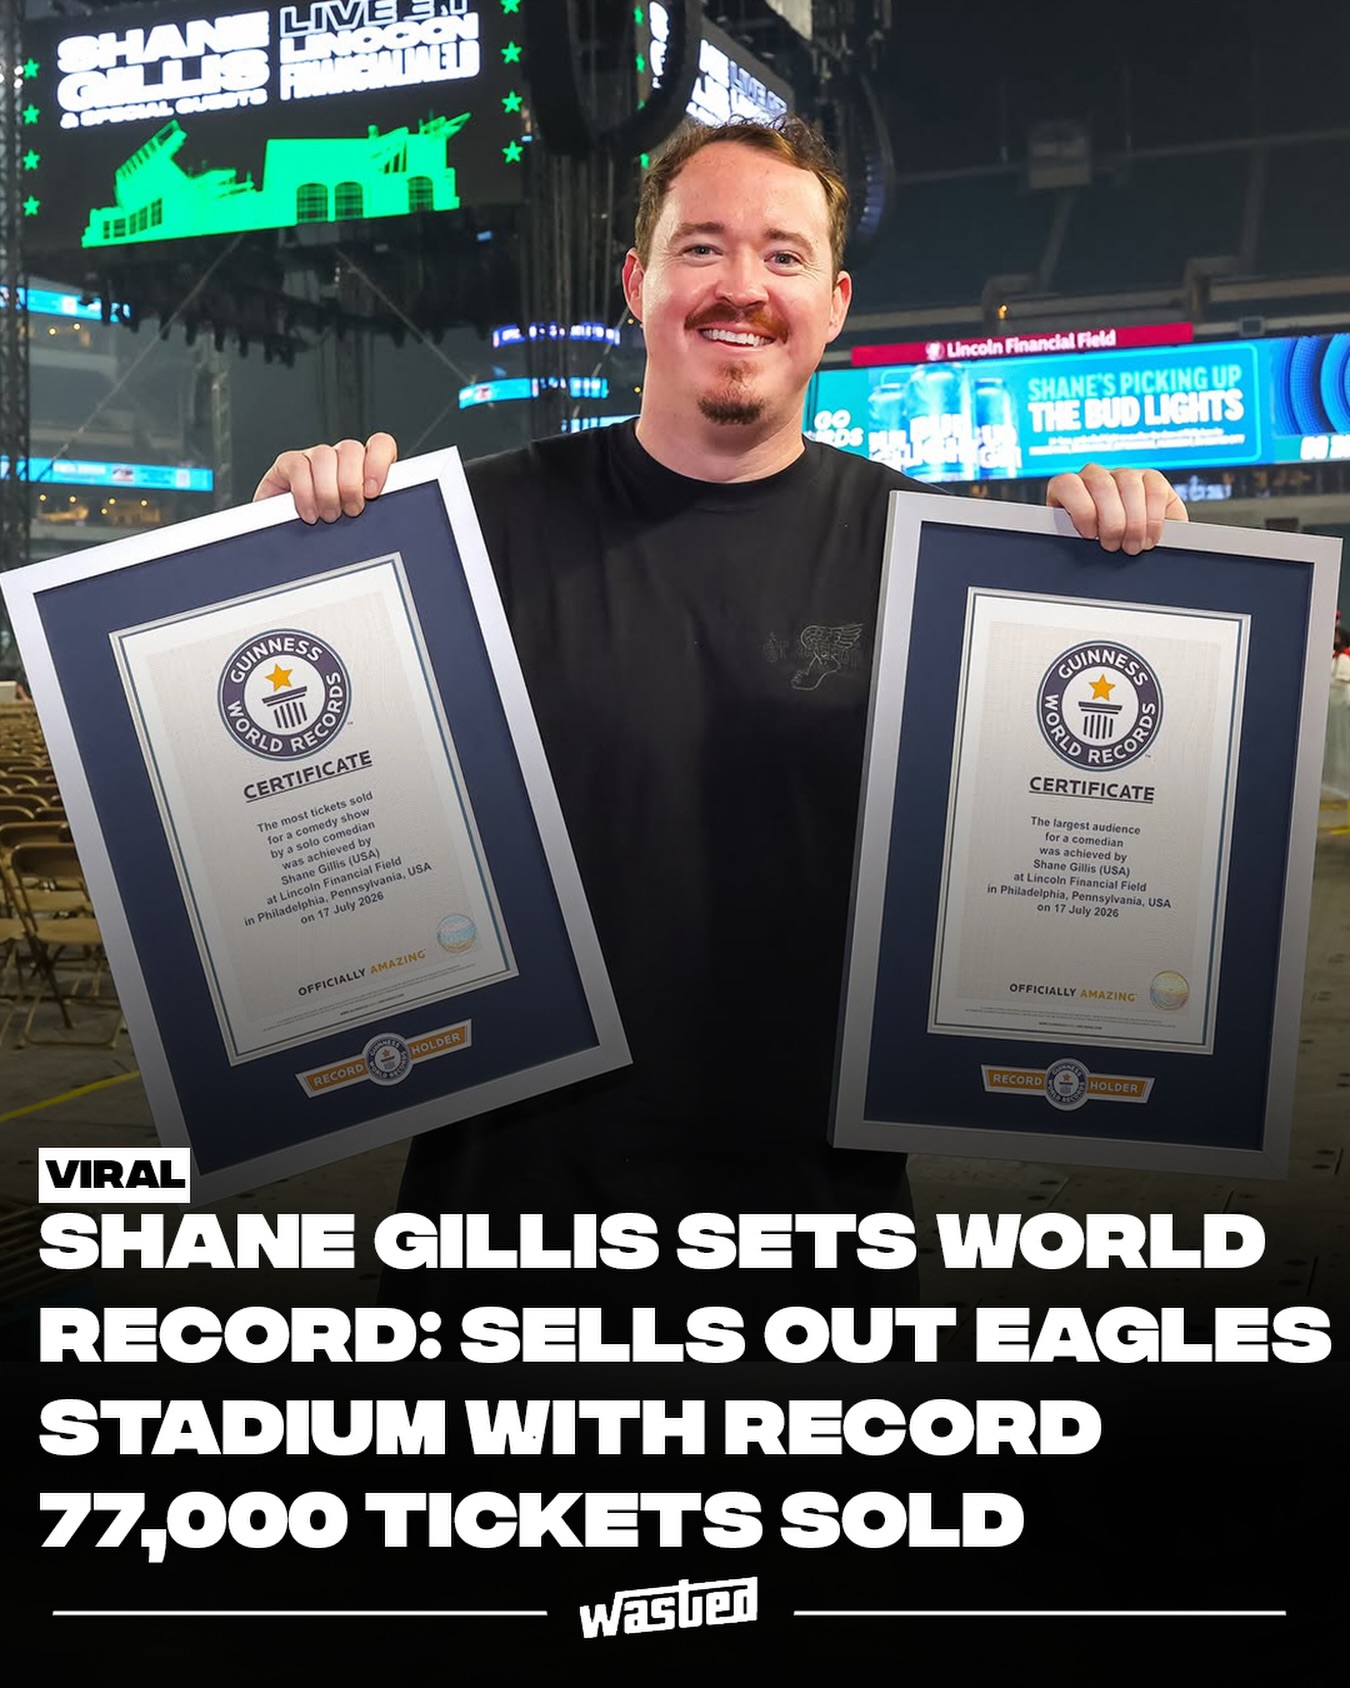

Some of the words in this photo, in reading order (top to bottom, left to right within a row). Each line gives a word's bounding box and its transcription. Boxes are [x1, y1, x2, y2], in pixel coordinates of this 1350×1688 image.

[280, 0, 398, 37] LIVE
[57, 11, 270, 73] SHANE
[57, 49, 270, 112] GILLIS
[947, 338, 1004, 359] Lincoln
[1005, 332, 1076, 354] Financial
[1077, 329, 1116, 349] Field
[1028, 371, 1116, 400] SHANE'S
[1120, 367, 1208, 395] PICKING
[1213, 364, 1242, 389] UP
[814, 409, 851, 431] GO
[1028, 399, 1081, 433] THE
[1085, 396, 1140, 429] BUD
[1144, 388, 1244, 426] LIGHTS
[230, 637, 323, 683] GUINNESS
[1058, 649, 1148, 686] GUINNESS
[227, 700, 283, 752] WORLD
[290, 672, 344, 752] RECORDS
[1044, 694, 1082, 757] WORLD
[1088, 702, 1156, 764] RECORDS
[244, 750, 373, 800] CERTIFICATE
[1029, 776, 1156, 803] CERTIFICATE
[256, 820, 279, 833] The
[280, 810, 309, 827] most
[309, 800, 348, 818] tickets
[348, 790, 374, 806] sold
[267, 834, 284, 846] for
[285, 831, 294, 840] a
[295, 817, 338, 837] comedy
[340, 808, 370, 824] show
[1030, 815, 1050, 827] The
[1052, 817, 1089, 831] largest
[1091, 822, 1140, 835] audience
[269, 848, 284, 860] by
[286, 845, 294, 855] a
[295, 837, 321, 852] solo
[322, 821, 376, 844] comedian
[281, 857, 305, 870] was
[306, 840, 356, 863] achieved
[357, 837, 372, 848] by
[1039, 847, 1060, 856] was
[1063, 848, 1111, 860] achieved
[1113, 851, 1127, 864] by
[1045, 831, 1060, 841] for
[1062, 835, 1069, 843] a
[1071, 835, 1123, 847] comedian
[266, 894, 278, 906] at
[279, 882, 321, 902] Lincoln
[322, 864, 374, 888] Financial
[374, 855, 403, 872] Field
[280, 869, 316, 886] Shane
[317, 859, 347, 875] Gillis
[348, 847, 381, 867] (USA)
[1013, 872, 1024, 881] at
[1026, 872, 1066, 885] Lincoln
[1069, 875, 1118, 889] Financial
[1120, 880, 1147, 892] Field
[1032, 858, 1066, 871] Shane
[1069, 861, 1096, 873] Gillis
[1099, 864, 1130, 878] (USA)
[243, 917, 256, 927] in
[256, 895, 329, 923] Philadelphia,
[329, 872, 407, 901] Pennsylvania,
[406, 861, 433, 877] USA
[300, 913, 316, 925] on
[317, 906, 330, 919] 17
[333, 901, 356, 915] July
[357, 890, 385, 907] 2026
[986, 883, 997, 893] in
[1000, 884, 1068, 900] Philadelphia,
[1071, 890, 1144, 907] Pennsylvania,
[1148, 897, 1171, 908] USA
[1036, 903, 1050, 912] on
[1054, 903, 1066, 913] 17
[1068, 904, 1091, 917] July
[1093, 906, 1119, 917] 2026
[298, 968, 366, 997] OFFICIALLY
[370, 949, 425, 975] AMAZING
[1009, 982, 1076, 997] OFFICIALLY
[1080, 989, 1136, 1002] AMAZING
[313, 1063, 364, 1087] RECORD
[411, 1032, 461, 1055] HOLDER
[993, 1073, 1042, 1086] RECORD
[1090, 1080, 1139, 1093] HOLDER
